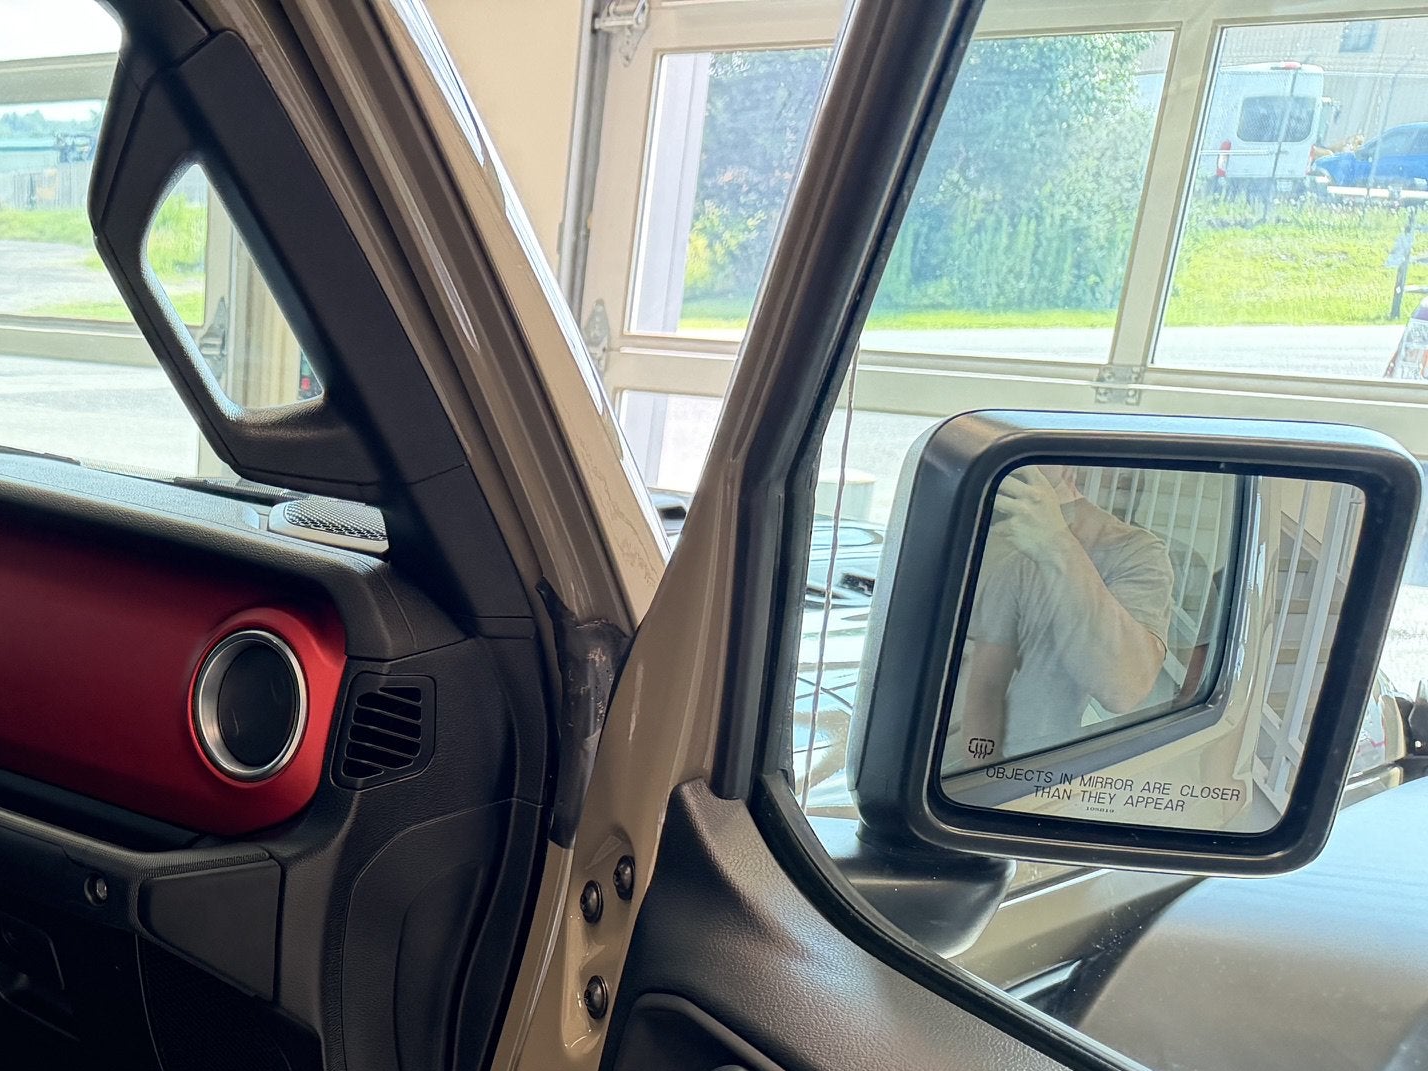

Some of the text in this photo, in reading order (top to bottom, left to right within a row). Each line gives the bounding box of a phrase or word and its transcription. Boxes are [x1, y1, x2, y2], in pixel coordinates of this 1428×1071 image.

[986, 767, 1241, 802] OBJECTS IN MIRROR ARE CLOSER
[1033, 785, 1185, 812] THAN THEY APPEAR
